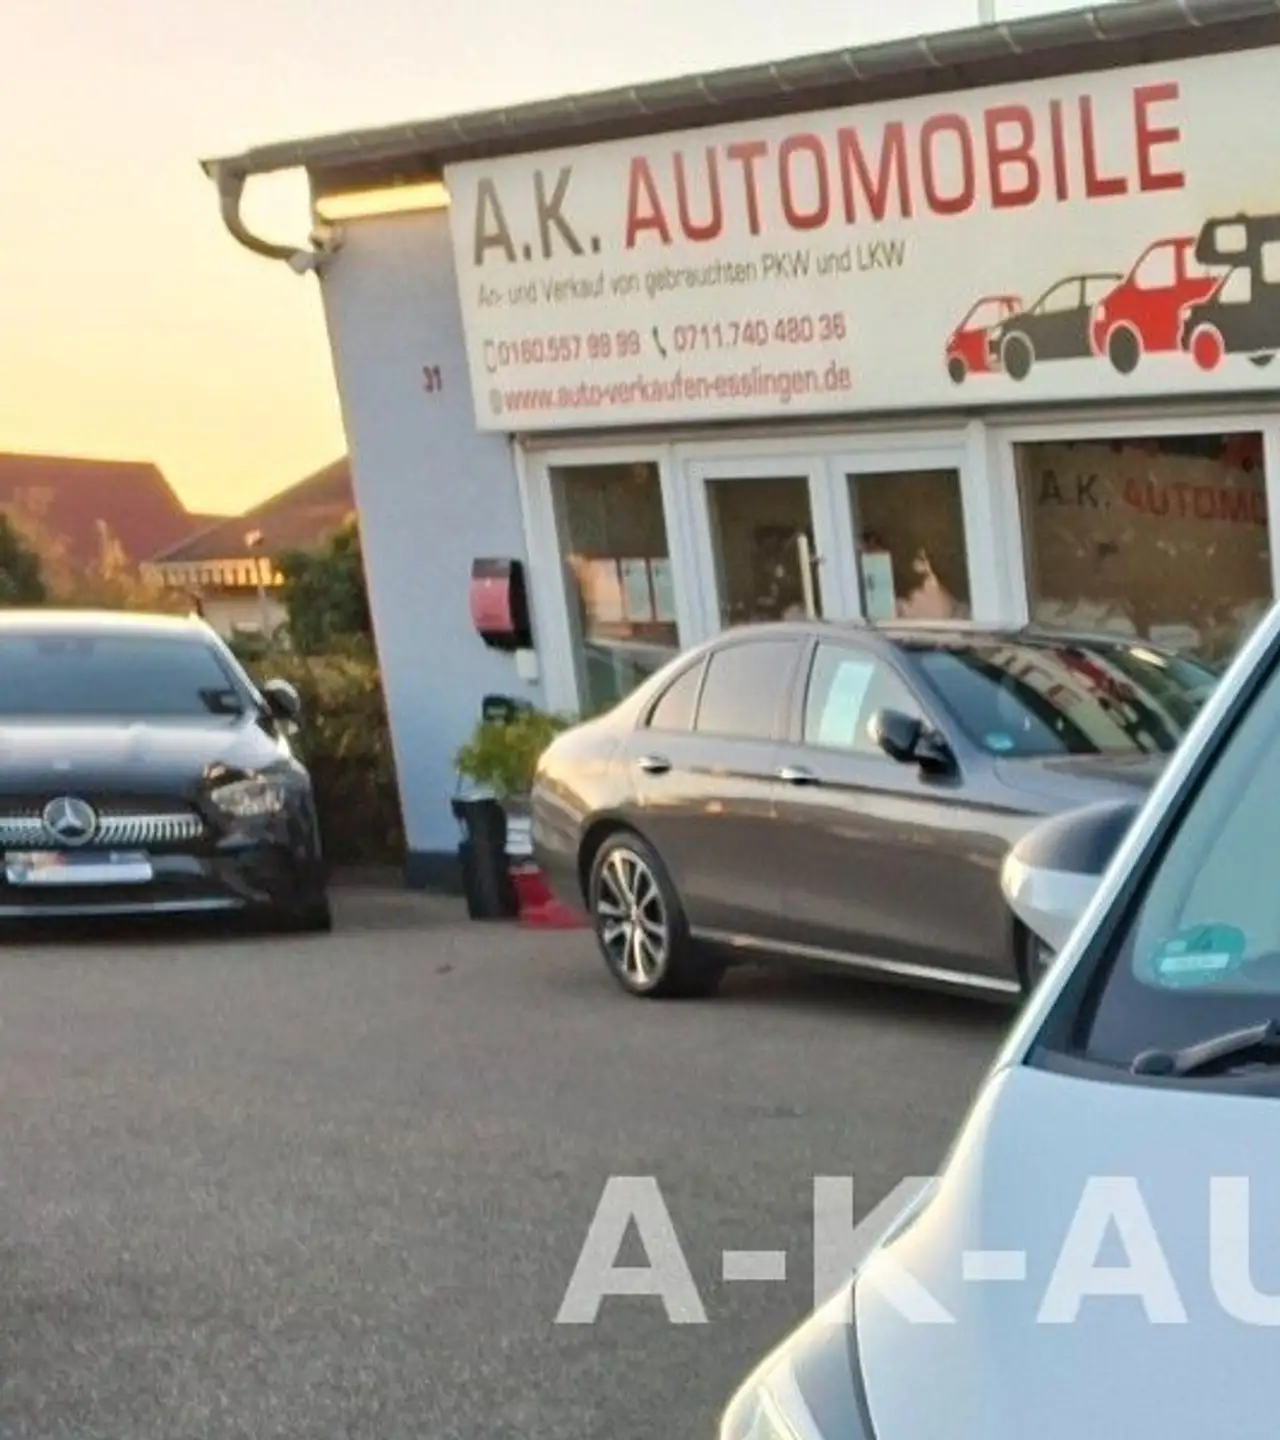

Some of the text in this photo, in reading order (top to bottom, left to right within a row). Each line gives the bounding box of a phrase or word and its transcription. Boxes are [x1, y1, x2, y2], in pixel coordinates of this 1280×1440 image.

[474, 82, 1186, 266] A.K. AUTOMOBILE
[645, 258, 757, 300] gebrauchten
[761, 248, 810, 279] PKW
[816, 244, 853, 276] und
[856, 239, 906, 272] LKW
